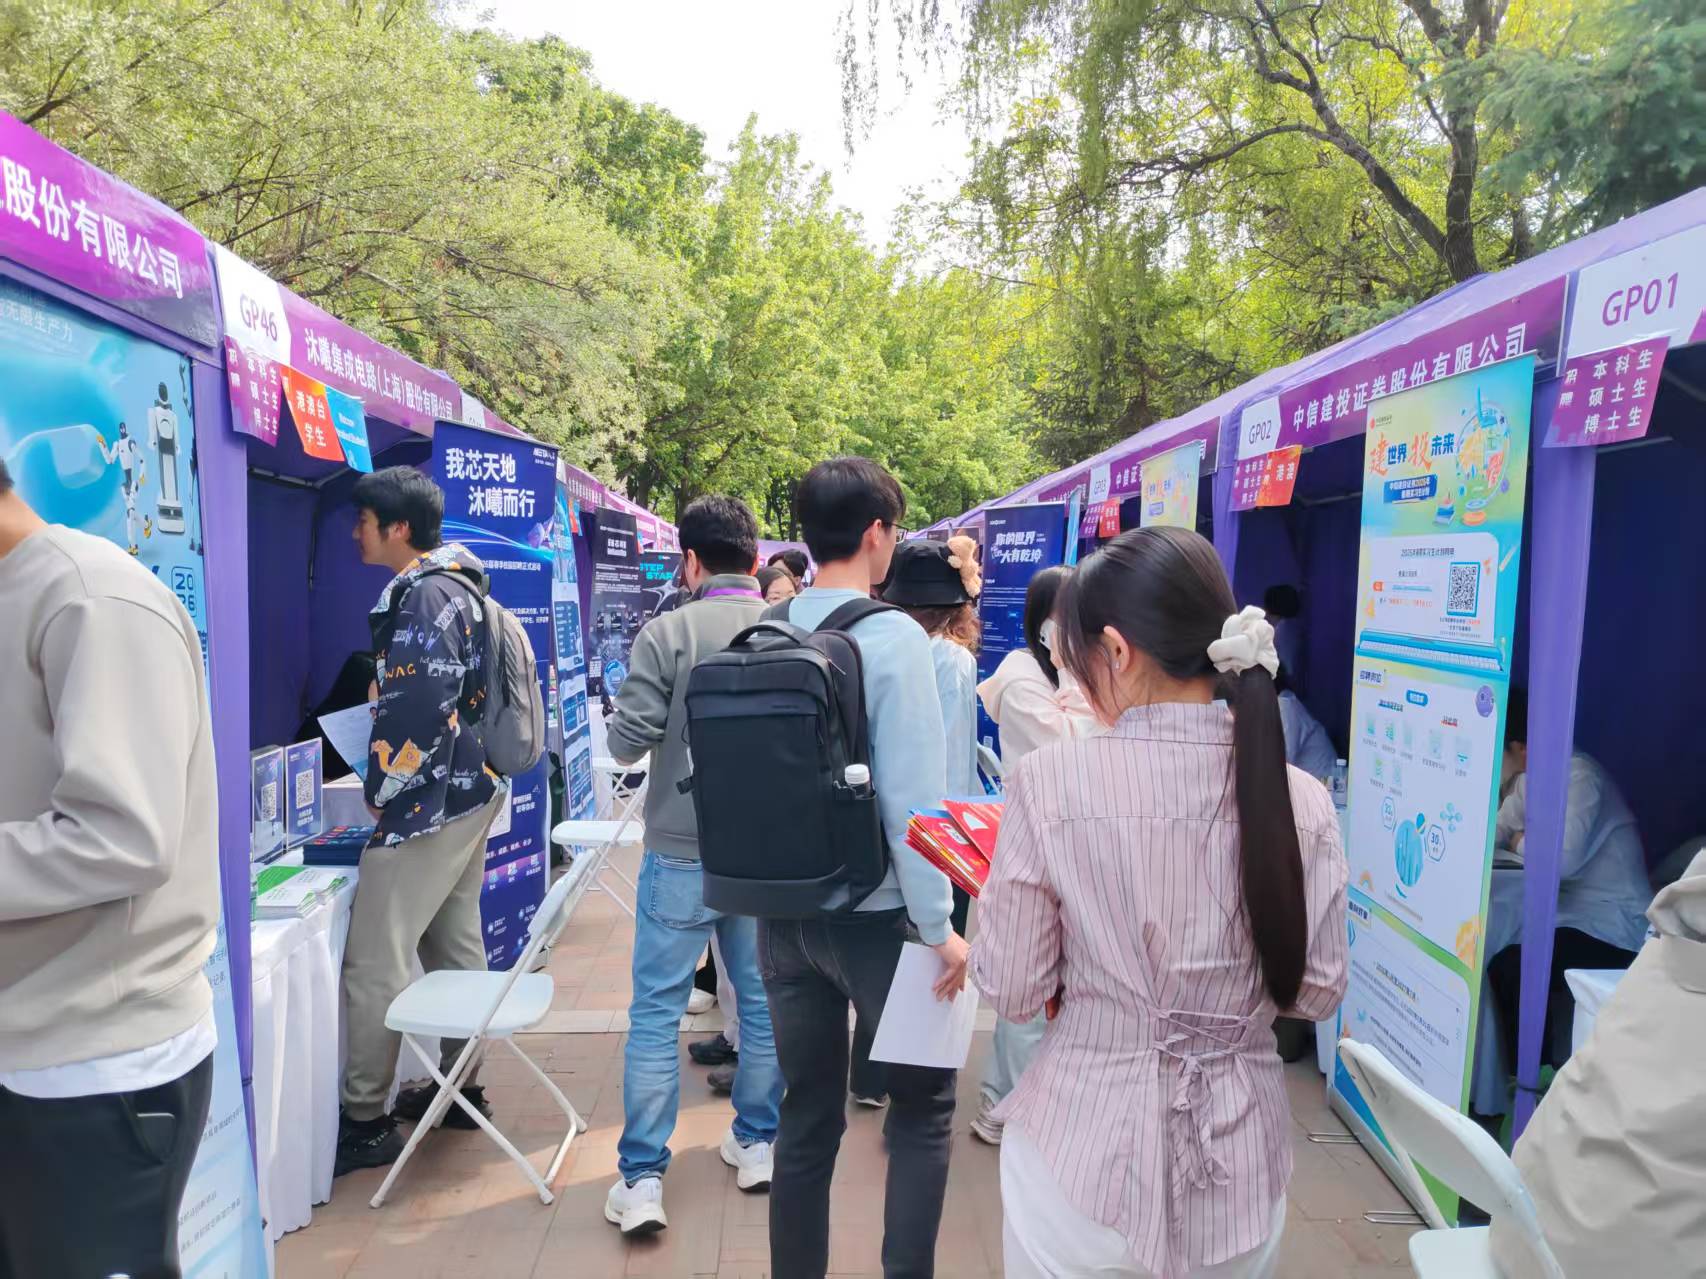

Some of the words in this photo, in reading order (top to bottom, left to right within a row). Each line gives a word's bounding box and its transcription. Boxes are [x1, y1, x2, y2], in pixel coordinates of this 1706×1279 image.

[1, 157, 183, 299] 股份有限公司
[1602, 272, 1679, 326] GP01
[240, 293, 278, 342] GP46
[1292, 322, 1526, 432] 中信建投证券股份有限公司
[1593, 349, 1653, 380] 本科生
[296, 389, 326, 420] 港澳台
[1588, 377, 1648, 408] 硕士生
[304, 422, 327, 447] 学生
[1249, 420, 1272, 445] GP02
[1584, 405, 1642, 434] 博士生
[445, 447, 517, 483] 我芯天地
[468, 486, 536, 518] 沐曦而行
[995, 530, 1036, 546] 你的世界
[175, 573, 194, 591] 20
